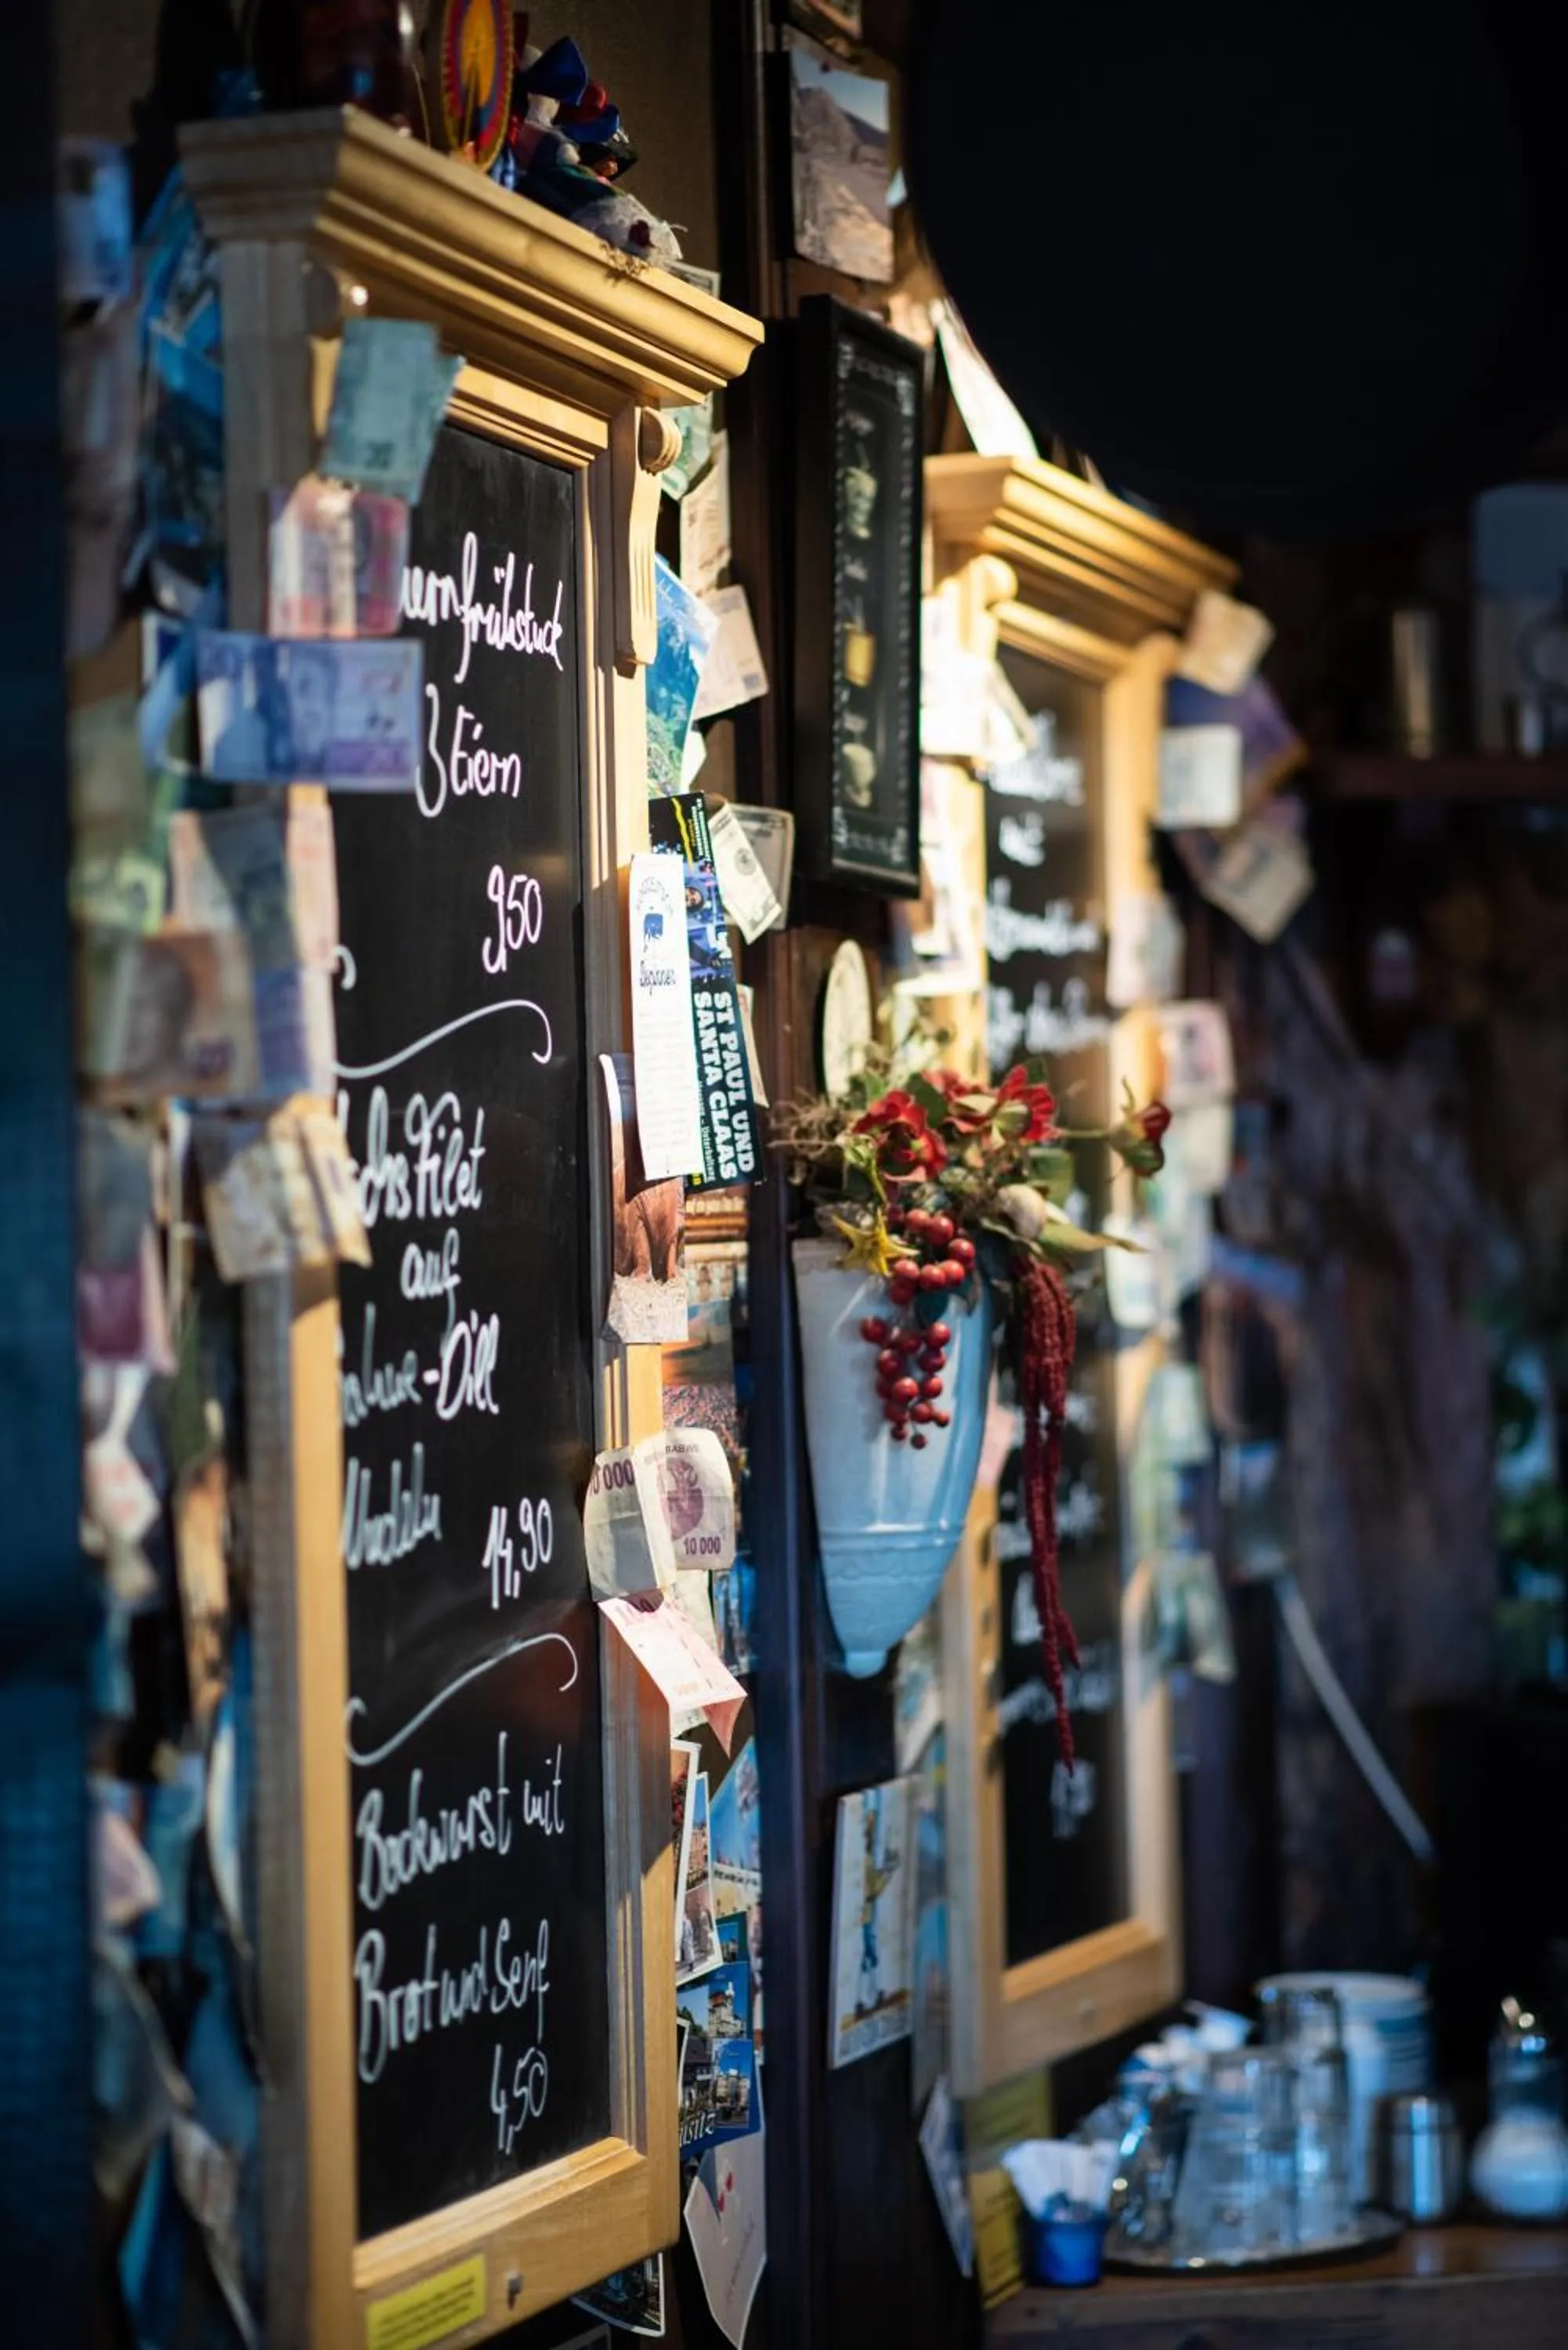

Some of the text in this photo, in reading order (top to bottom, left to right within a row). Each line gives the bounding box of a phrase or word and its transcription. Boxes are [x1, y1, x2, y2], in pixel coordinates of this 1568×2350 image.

[450, 704, 522, 799] Eiern
[693, 992, 738, 1180] SANTA CLAAS
[714, 990, 756, 1174] ST PAUL UND
[400, 1227, 461, 1357] auf
[356, 1730, 512, 1911] Bockwurst
[490, 2043, 548, 2156] 4,50
